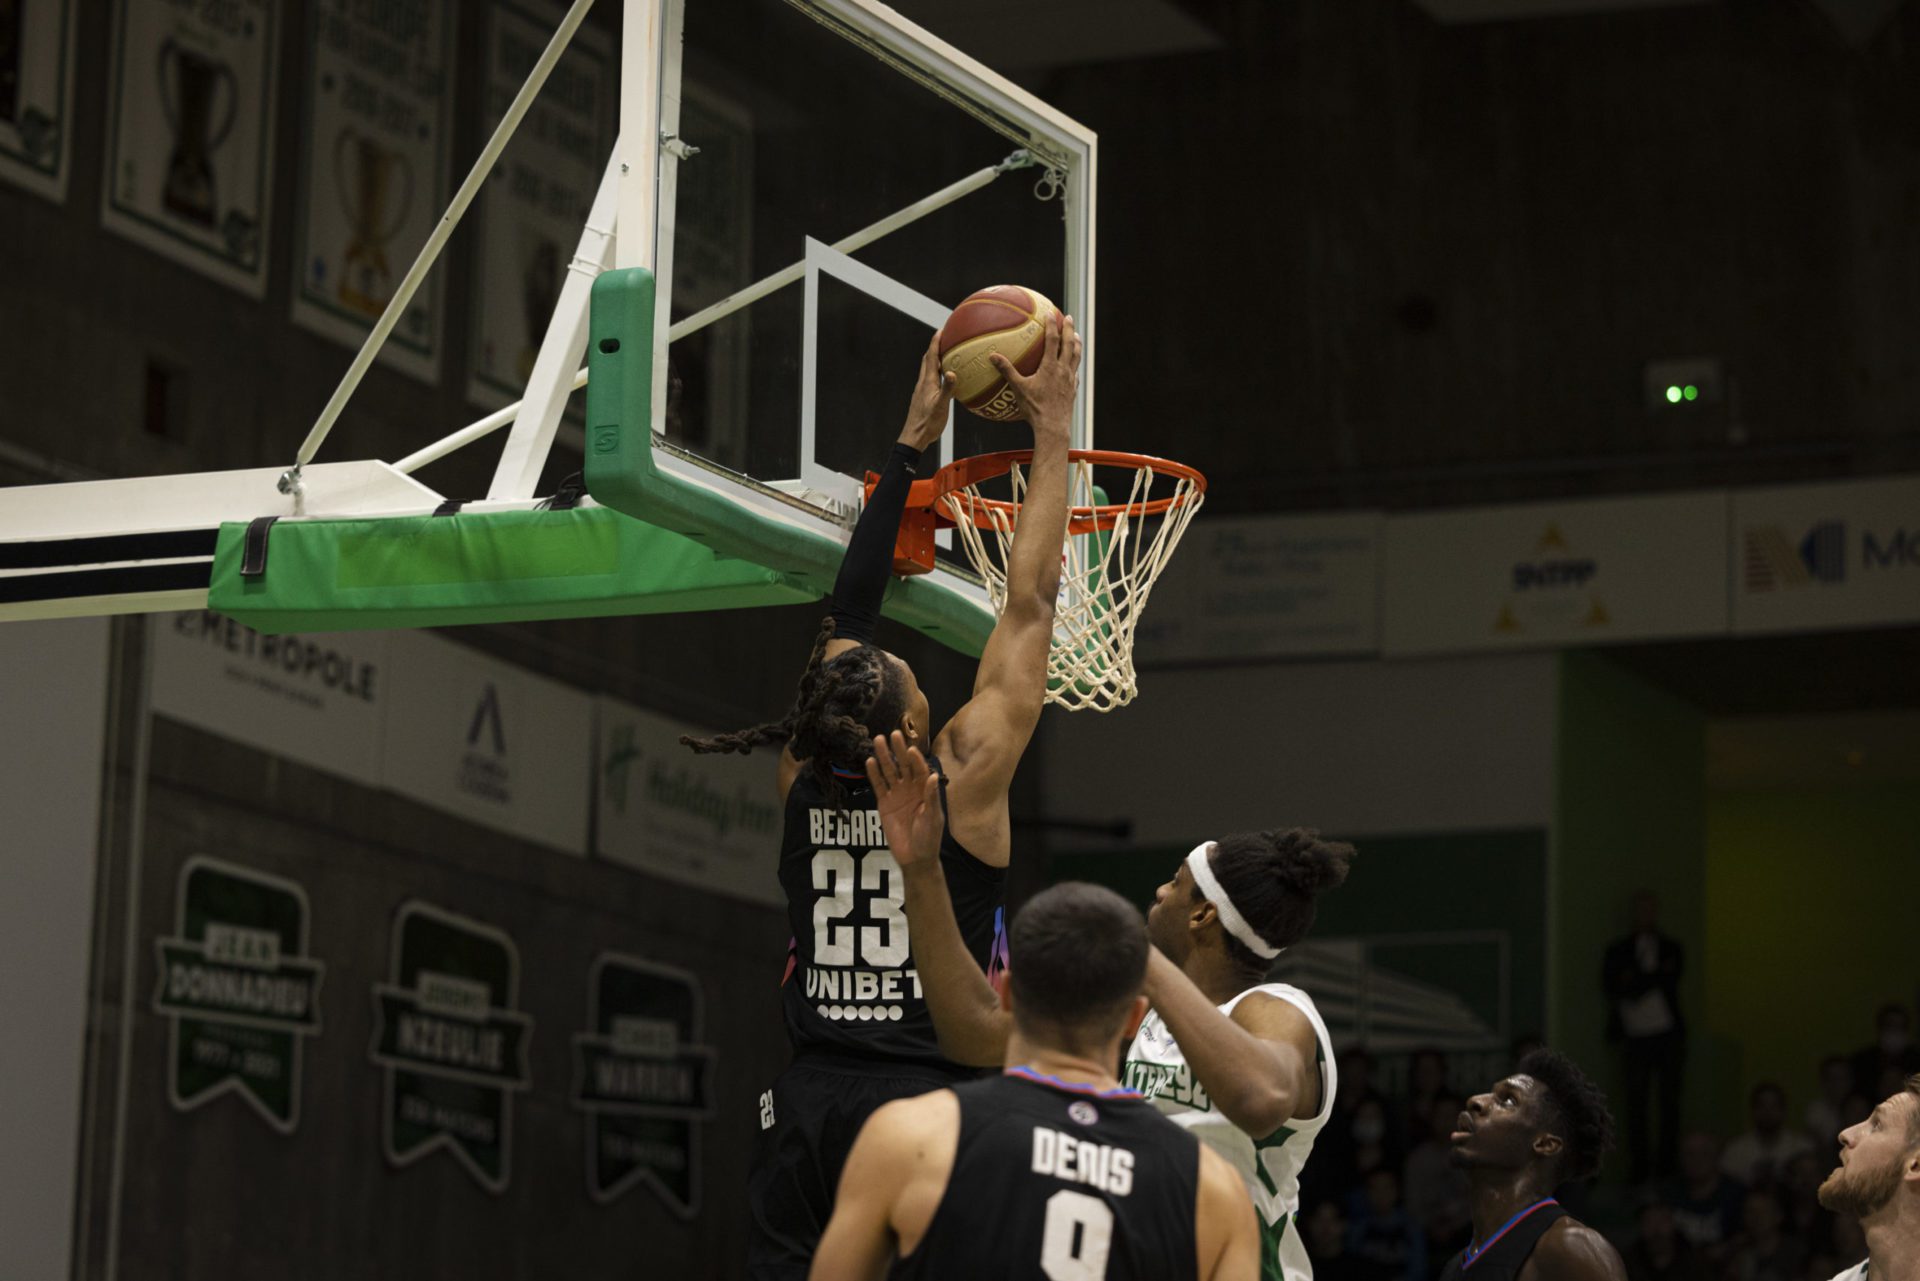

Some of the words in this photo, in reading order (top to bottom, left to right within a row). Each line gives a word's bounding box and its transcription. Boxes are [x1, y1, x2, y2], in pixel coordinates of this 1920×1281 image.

[809, 808, 889, 847] BEGAR
[811, 849, 909, 967] 23
[806, 967, 923, 1000] UNIBET
[760, 1089, 776, 1130] 23
[1032, 1126, 1135, 1197] DENIS
